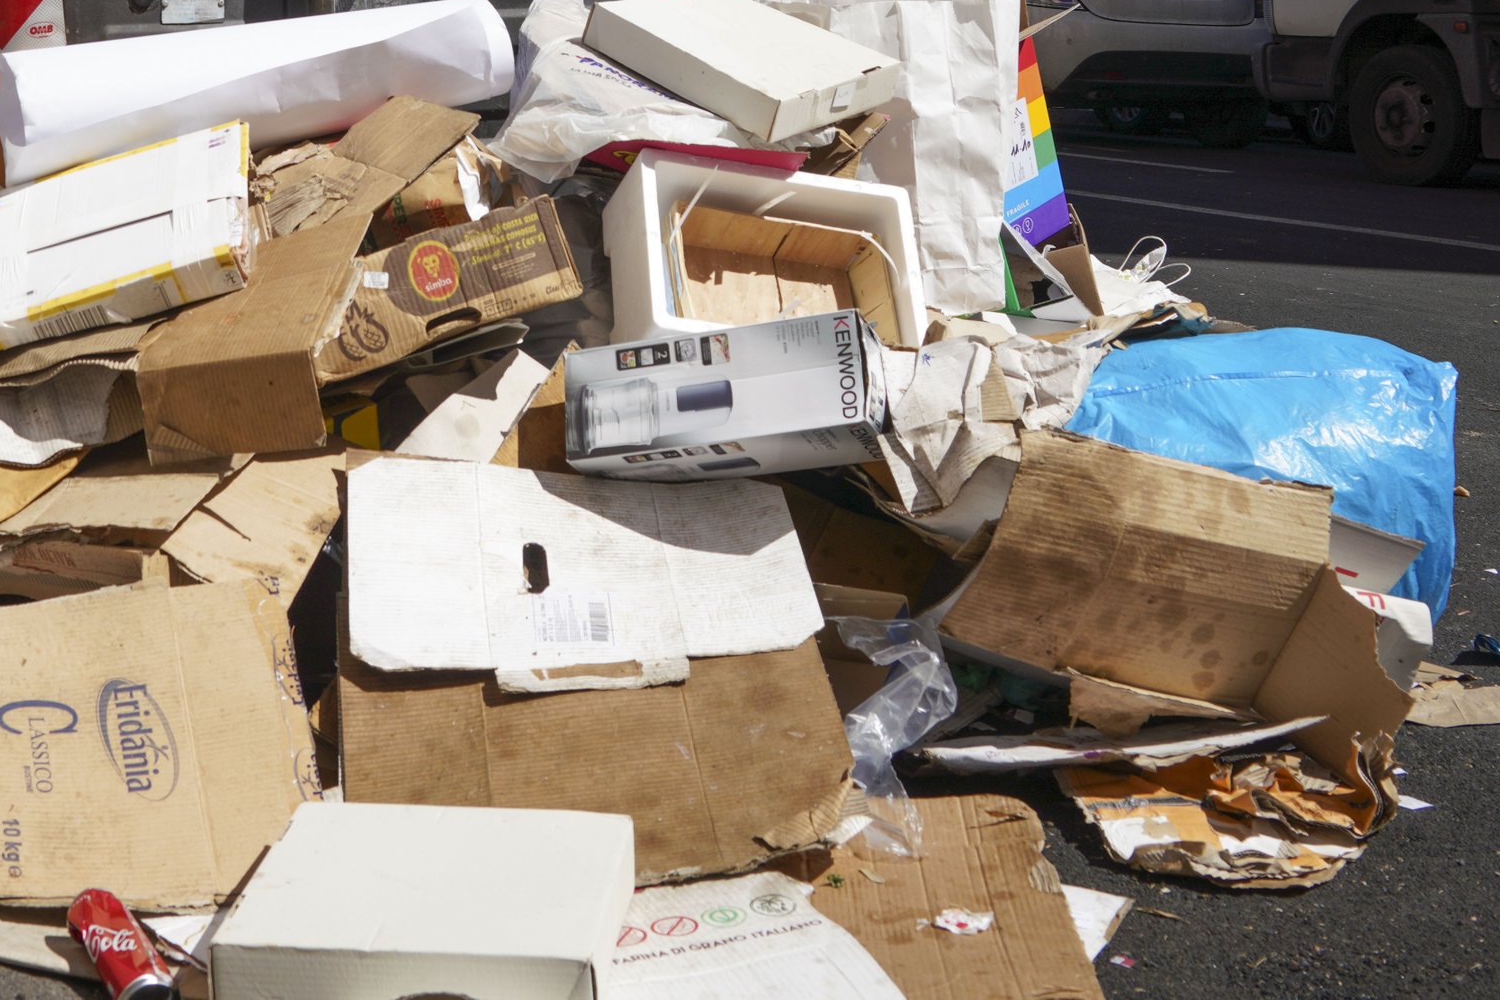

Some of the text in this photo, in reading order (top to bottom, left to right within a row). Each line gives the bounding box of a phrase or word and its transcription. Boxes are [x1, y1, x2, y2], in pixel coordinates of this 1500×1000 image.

[29, 24, 54, 36] OMB
[502, 217, 523, 230] COSTA
[524, 212, 540, 222] RICA
[1006, 199, 1030, 218] FRAGILE
[424, 277, 453, 292] simba
[657, 350, 668, 360] 2
[833, 315, 858, 420] KENWOOD
[113, 683, 160, 794] Eridania
[1, 818, 23, 862] 10 kg
[84, 924, 138, 964] Cola
[612, 919, 823, 966] FARINA DI GRANO ITALIANO
